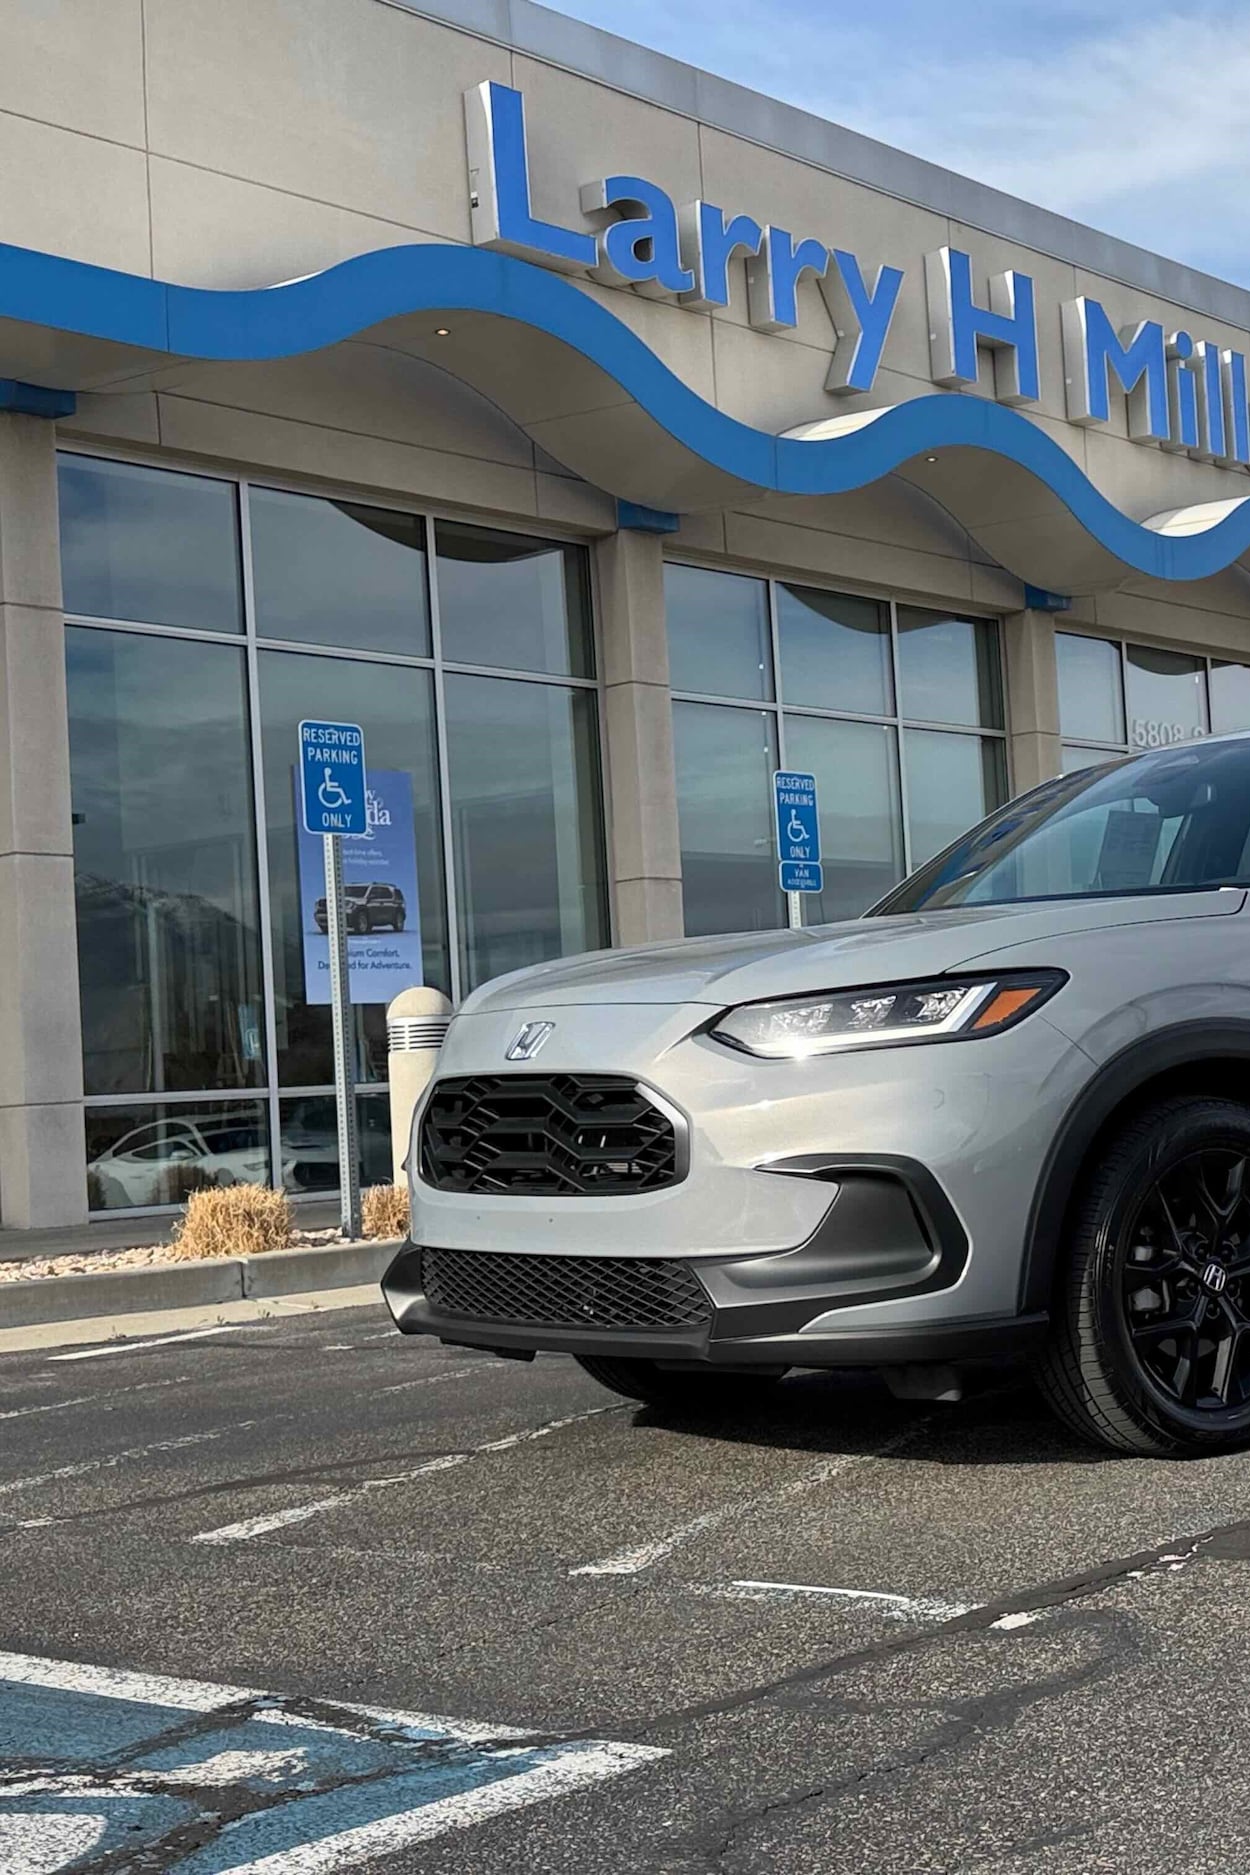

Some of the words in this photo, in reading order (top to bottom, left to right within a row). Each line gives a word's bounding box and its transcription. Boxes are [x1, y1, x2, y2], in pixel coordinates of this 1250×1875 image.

[484, 80, 904, 394] Larry
[940, 246, 1041, 404] H
[303, 727, 361, 747] RESERVED
[307, 746, 359, 765] PARKING
[776, 777, 815, 791] RESERVED
[780, 792, 813, 806] PARKING
[321, 811, 353, 829] ONLY
[790, 846, 810, 858] ONLY
